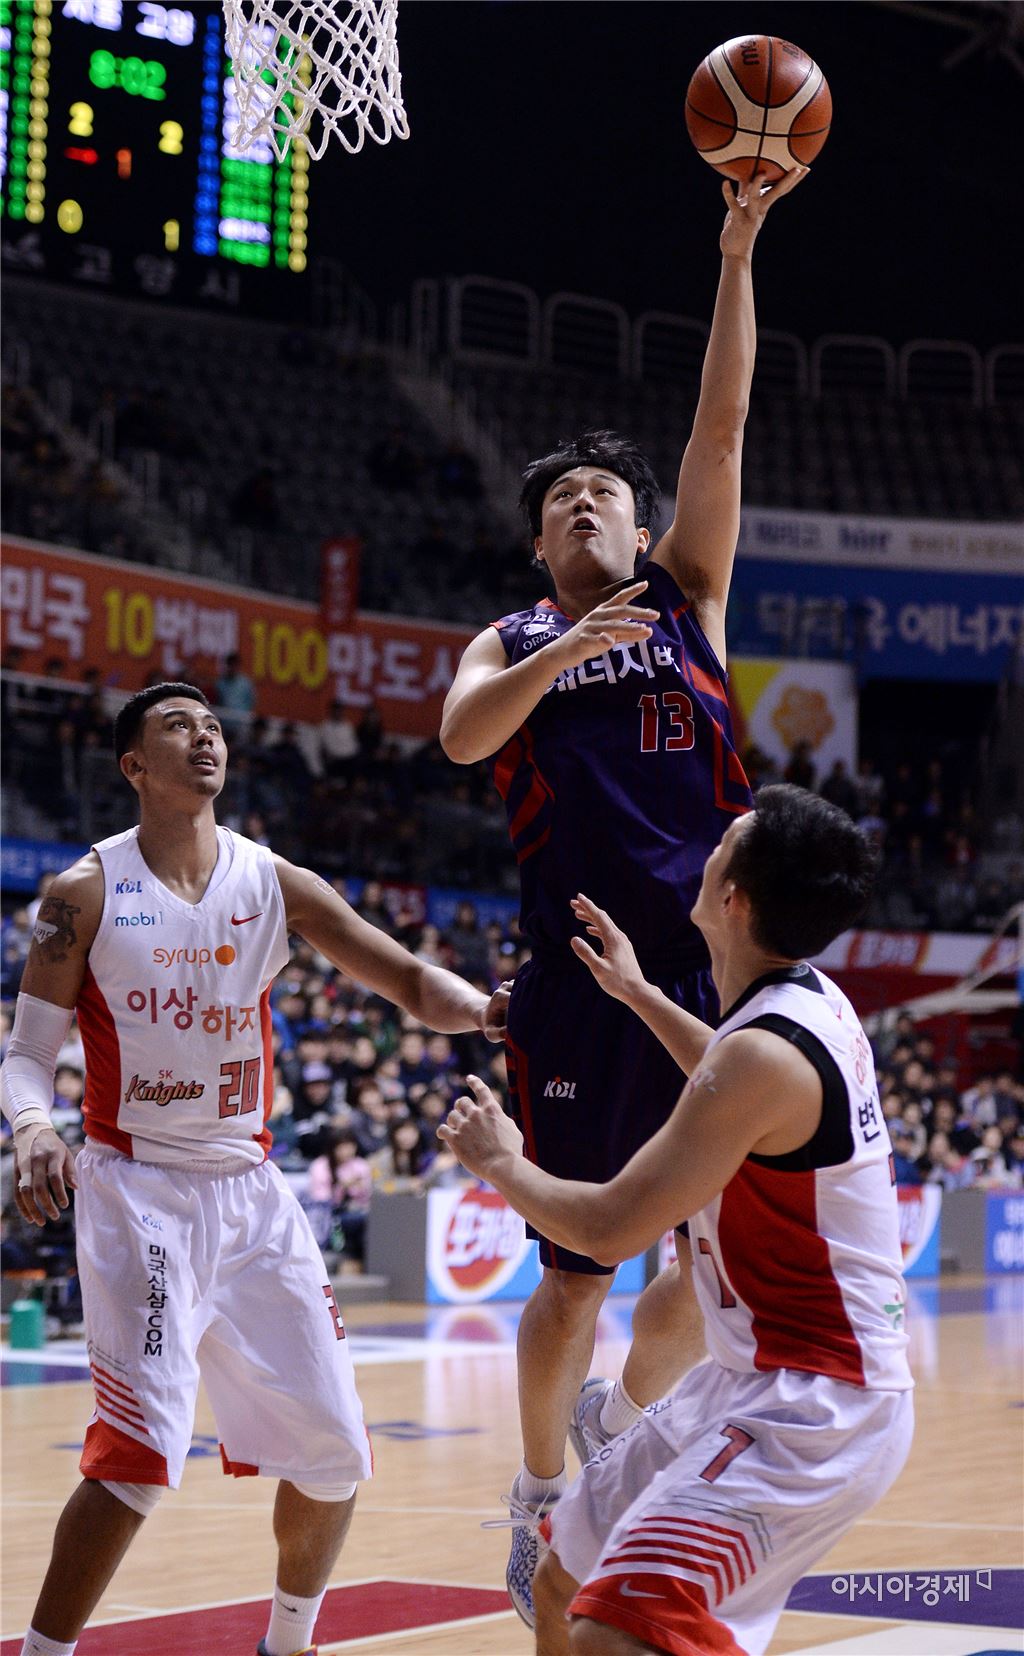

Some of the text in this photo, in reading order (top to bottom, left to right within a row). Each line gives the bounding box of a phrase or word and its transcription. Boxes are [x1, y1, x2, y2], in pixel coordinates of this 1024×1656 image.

[523, 631, 561, 650] ORION
[637, 691, 695, 752] 13
[153, 948, 211, 968] syrup
[158, 1069, 173, 1080] SK
[218, 1056, 260, 1119] 20
[544, 1076, 577, 1099] KBL
[125, 1073, 205, 1107] Knights
[858, 1097, 881, 1144] 변
